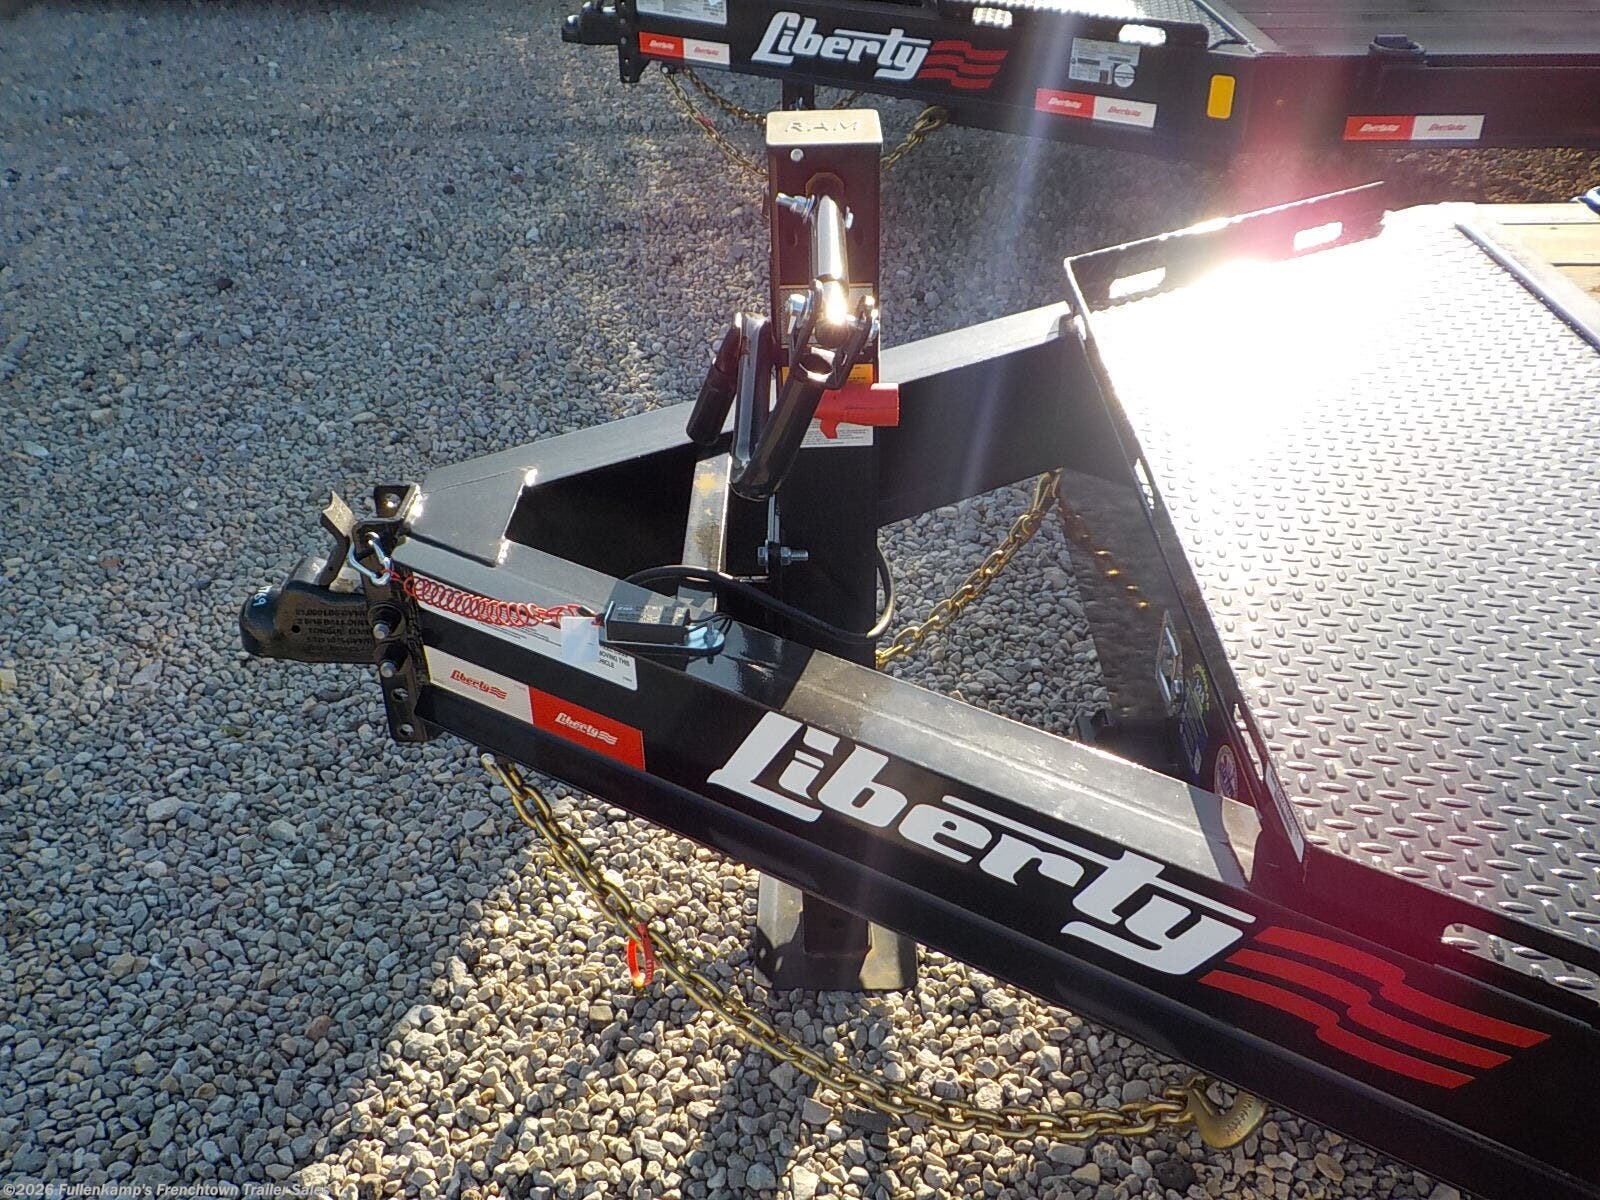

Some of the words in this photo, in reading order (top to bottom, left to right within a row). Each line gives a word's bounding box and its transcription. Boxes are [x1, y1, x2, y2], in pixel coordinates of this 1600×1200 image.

[751, 11, 931, 80] Liberty
[450, 669, 490, 693] Liberty
[554, 712, 598, 738] Liberty
[706, 710, 1256, 976] Liberty
